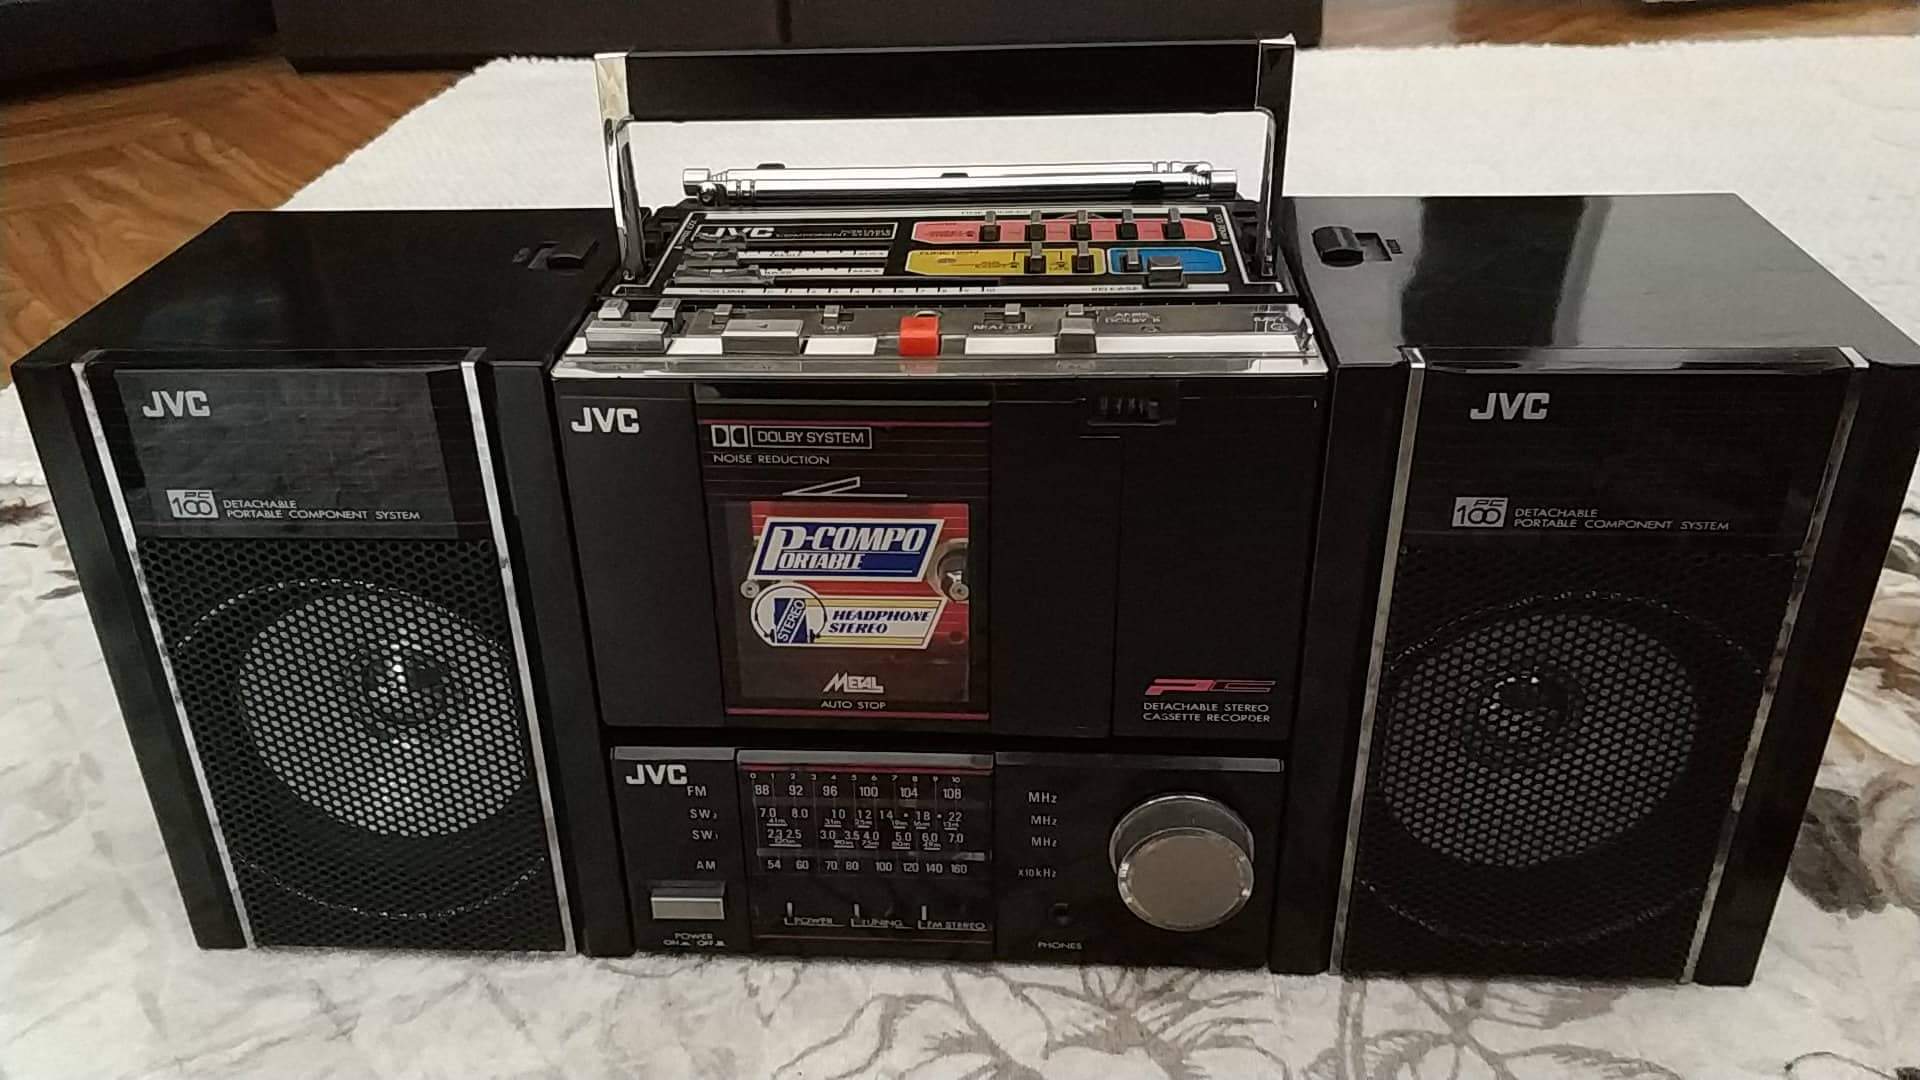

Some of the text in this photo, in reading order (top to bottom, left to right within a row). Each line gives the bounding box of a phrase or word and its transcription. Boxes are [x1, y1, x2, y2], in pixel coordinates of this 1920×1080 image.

[702, 227, 775, 238] JVC
[142, 391, 210, 417] JVC
[1470, 392, 1550, 420] JVC
[571, 407, 640, 433] JVC
[758, 430, 865, 444] DOLBY SYSTEM
[712, 454, 831, 466] NOISE REDUCTION
[223, 499, 298, 509] DETACHABLE
[226, 509, 421, 520] PORTABLE COMPONENT SYSTEM
[1514, 508, 1600, 518] DETACHABLE
[1513, 518, 1730, 531] PORTABLE COMPONENT SYSTEM
[777, 598, 807, 642] STEREO
[831, 609, 932, 622] HEADPHONE
[828, 622, 889, 635] STEREO
[822, 671, 885, 694] METAL
[820, 700, 888, 710] AUTO STOP
[1143, 702, 1269, 713] DETACHABLE STEREO
[1142, 712, 1271, 723] CASSETTE RECORDER
[625, 764, 688, 785] JVC
[687, 784, 1057, 804] FM 88 92 96 100 104 108 MHz
[831, 808, 846, 819] 10
[857, 809, 872, 820] 12
[880, 809, 894, 820] 14
[916, 811, 931, 821] 18
[948, 811, 963, 822] 22
[1030, 815, 1058, 826] MHz
[785, 829, 802, 839] 2.5
[1031, 836, 1057, 847] MHz
[696, 860, 717, 871] AM
[767, 860, 781, 870] 54
[796, 860, 809, 870] 60
[825, 861, 838, 871] 70
[845, 861, 860, 871] 80
[875, 862, 892, 872] 100
[903, 862, 919, 872] 120
[925, 863, 943, 873] 140
[951, 864, 968, 874] 160
[674, 932, 713, 940] POWER
[1037, 941, 1083, 950] PHONES
